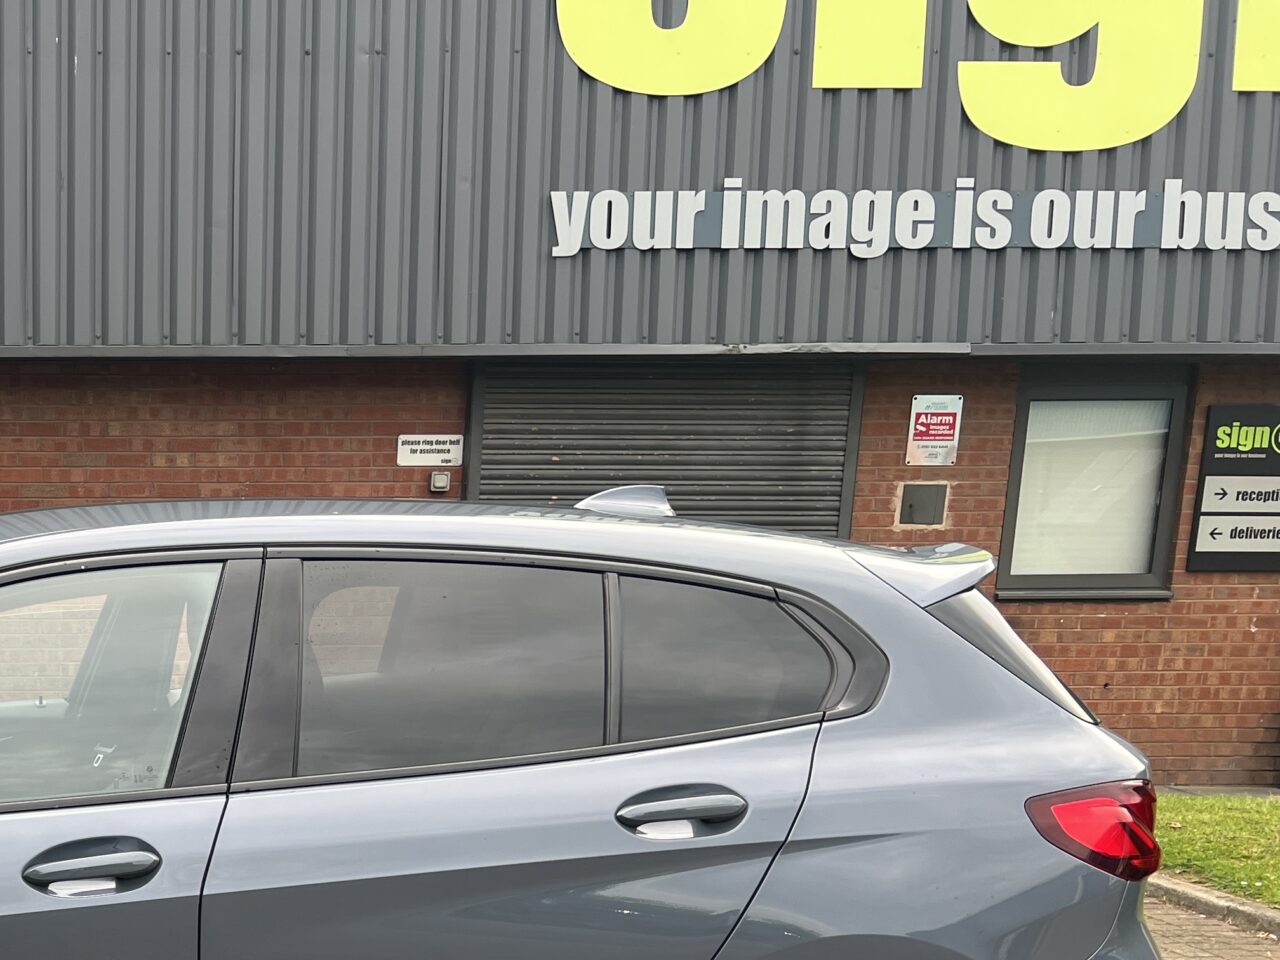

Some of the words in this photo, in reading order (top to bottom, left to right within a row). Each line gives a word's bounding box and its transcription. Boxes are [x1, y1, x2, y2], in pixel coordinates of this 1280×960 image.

[550, 189, 705, 257] your
[721, 177, 935, 258] image
[952, 177, 1013, 249] is
[1030, 189, 1147, 249] our
[918, 414, 953, 424] Alarm
[1216, 421, 1270, 451] sign
